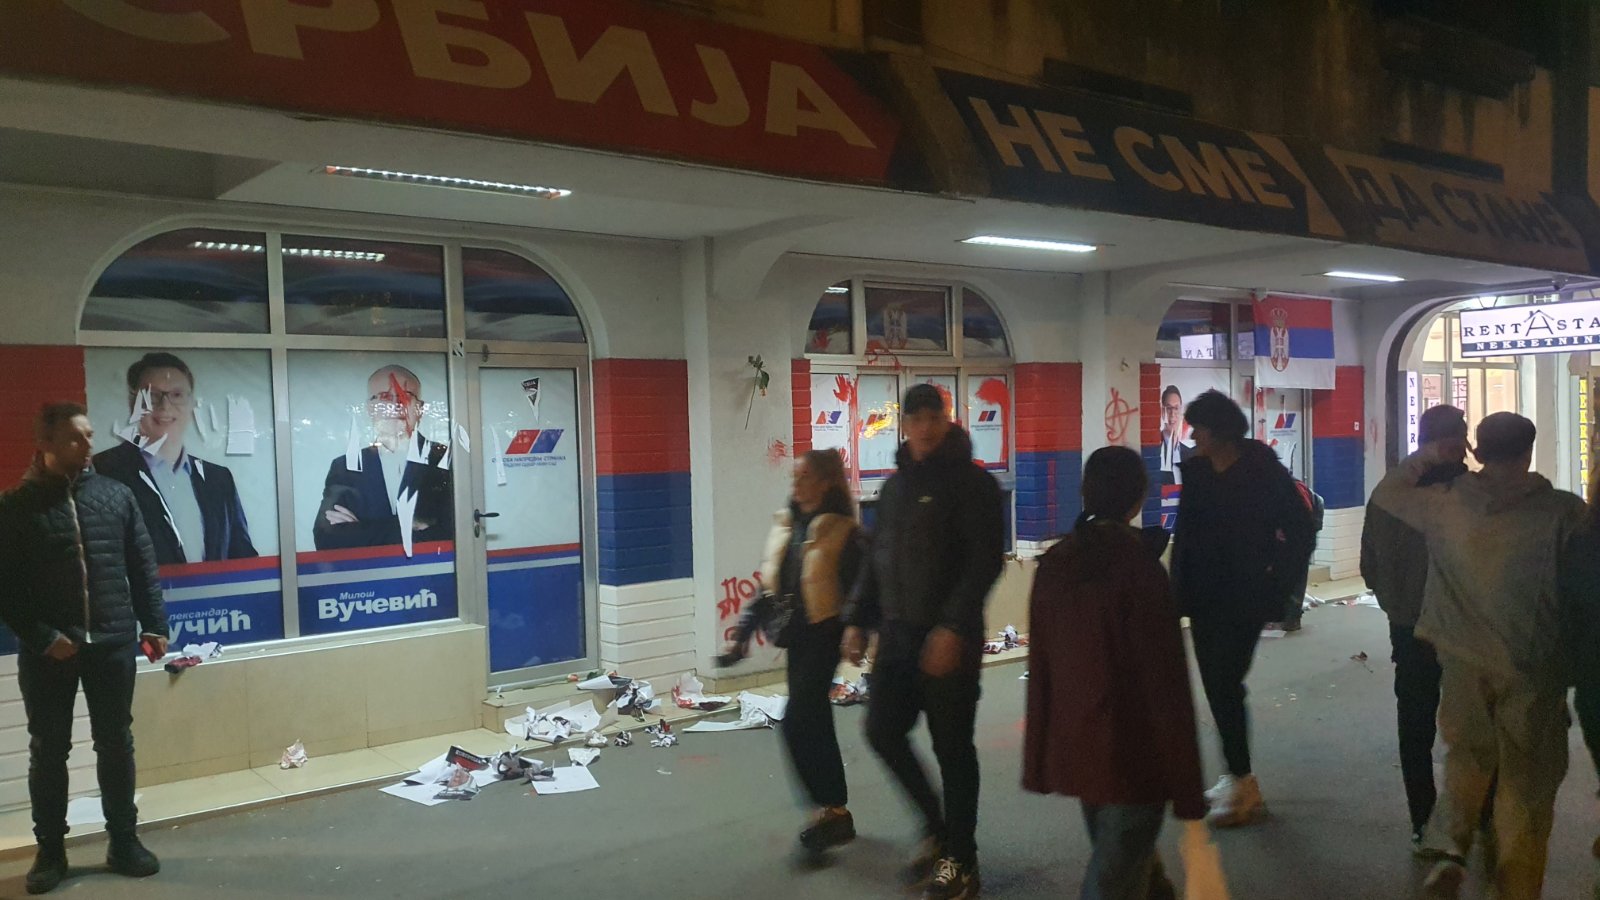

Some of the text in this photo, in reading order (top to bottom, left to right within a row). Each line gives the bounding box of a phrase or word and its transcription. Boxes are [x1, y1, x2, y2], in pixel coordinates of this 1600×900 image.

[968, 97, 1294, 208] НЕ СМЕ
[1344, 164, 1577, 248] ДА СТАНЕ
[1476, 335, 1600, 350] NEKRETNIN
[318, 588, 437, 622] Вучевић
[339, 590, 375, 600] Милош
[168, 609, 251, 645] учић
[169, 606, 229, 621] лександар
